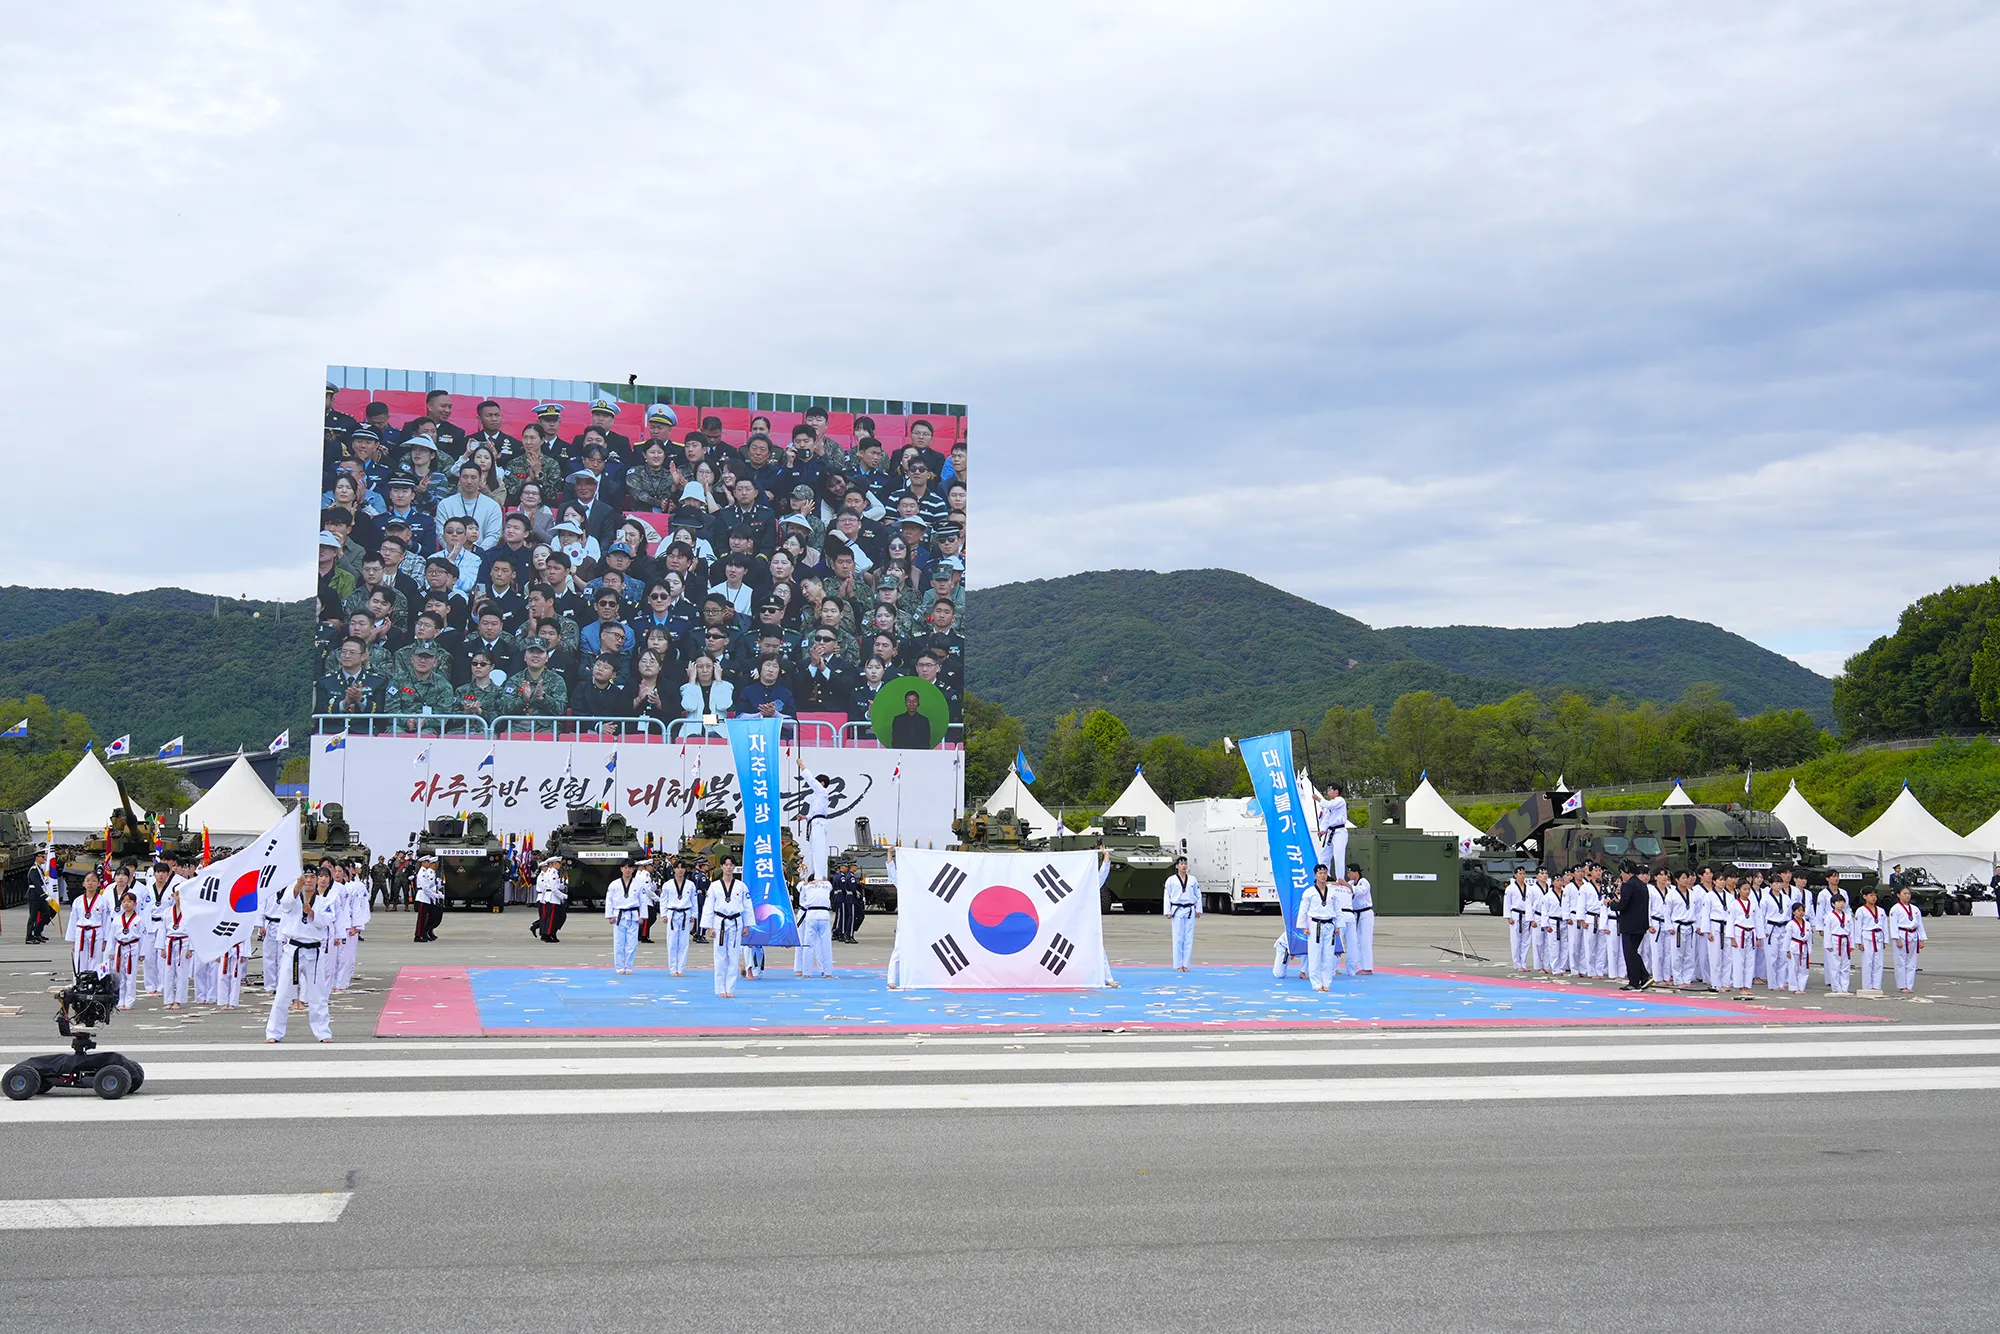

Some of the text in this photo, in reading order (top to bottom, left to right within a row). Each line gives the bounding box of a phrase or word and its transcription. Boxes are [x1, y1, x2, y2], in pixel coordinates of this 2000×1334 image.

[410, 773, 529, 809] 자주국방
[626, 773, 744, 818] 대체불
[748, 734, 776, 900] 자주국방 실현!
[1260, 748, 1310, 889] 대체불가 국군
